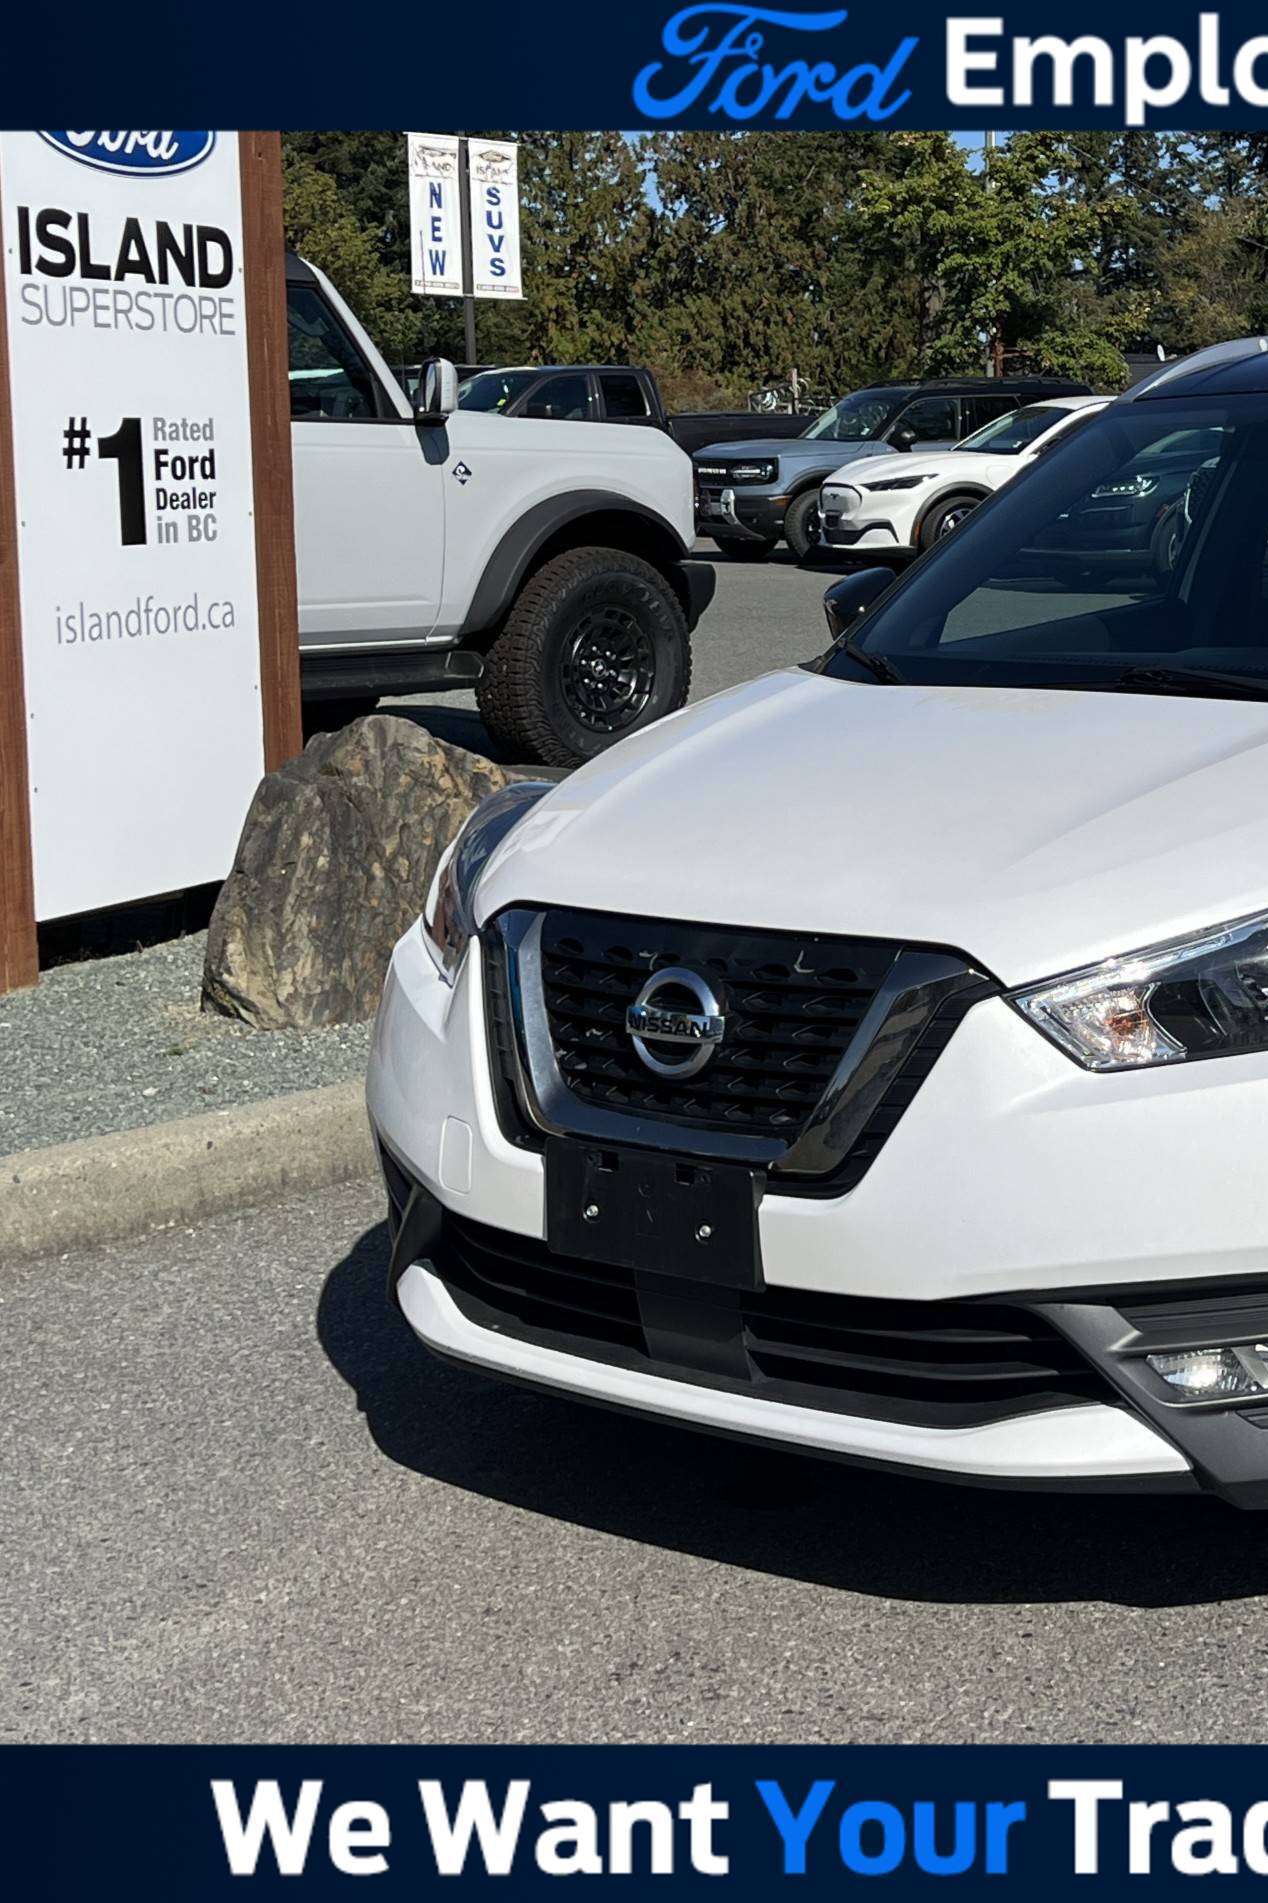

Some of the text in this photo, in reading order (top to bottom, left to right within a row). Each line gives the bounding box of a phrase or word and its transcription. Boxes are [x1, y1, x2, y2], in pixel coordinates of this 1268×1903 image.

[16, 205, 234, 289] ISLAND
[429, 182, 446, 276] NEW
[486, 187, 506, 277] SUVS
[20, 282, 236, 335] SUPERSTORE
[152, 416, 215, 442] Rated
[62, 416, 147, 546] #1
[154, 448, 216, 481] Ford
[155, 486, 217, 511] Dealer
[156, 512, 218, 544] in BC
[55, 592, 236, 645] islandford.ca
[629, 1010, 708, 1038] NISSAN
